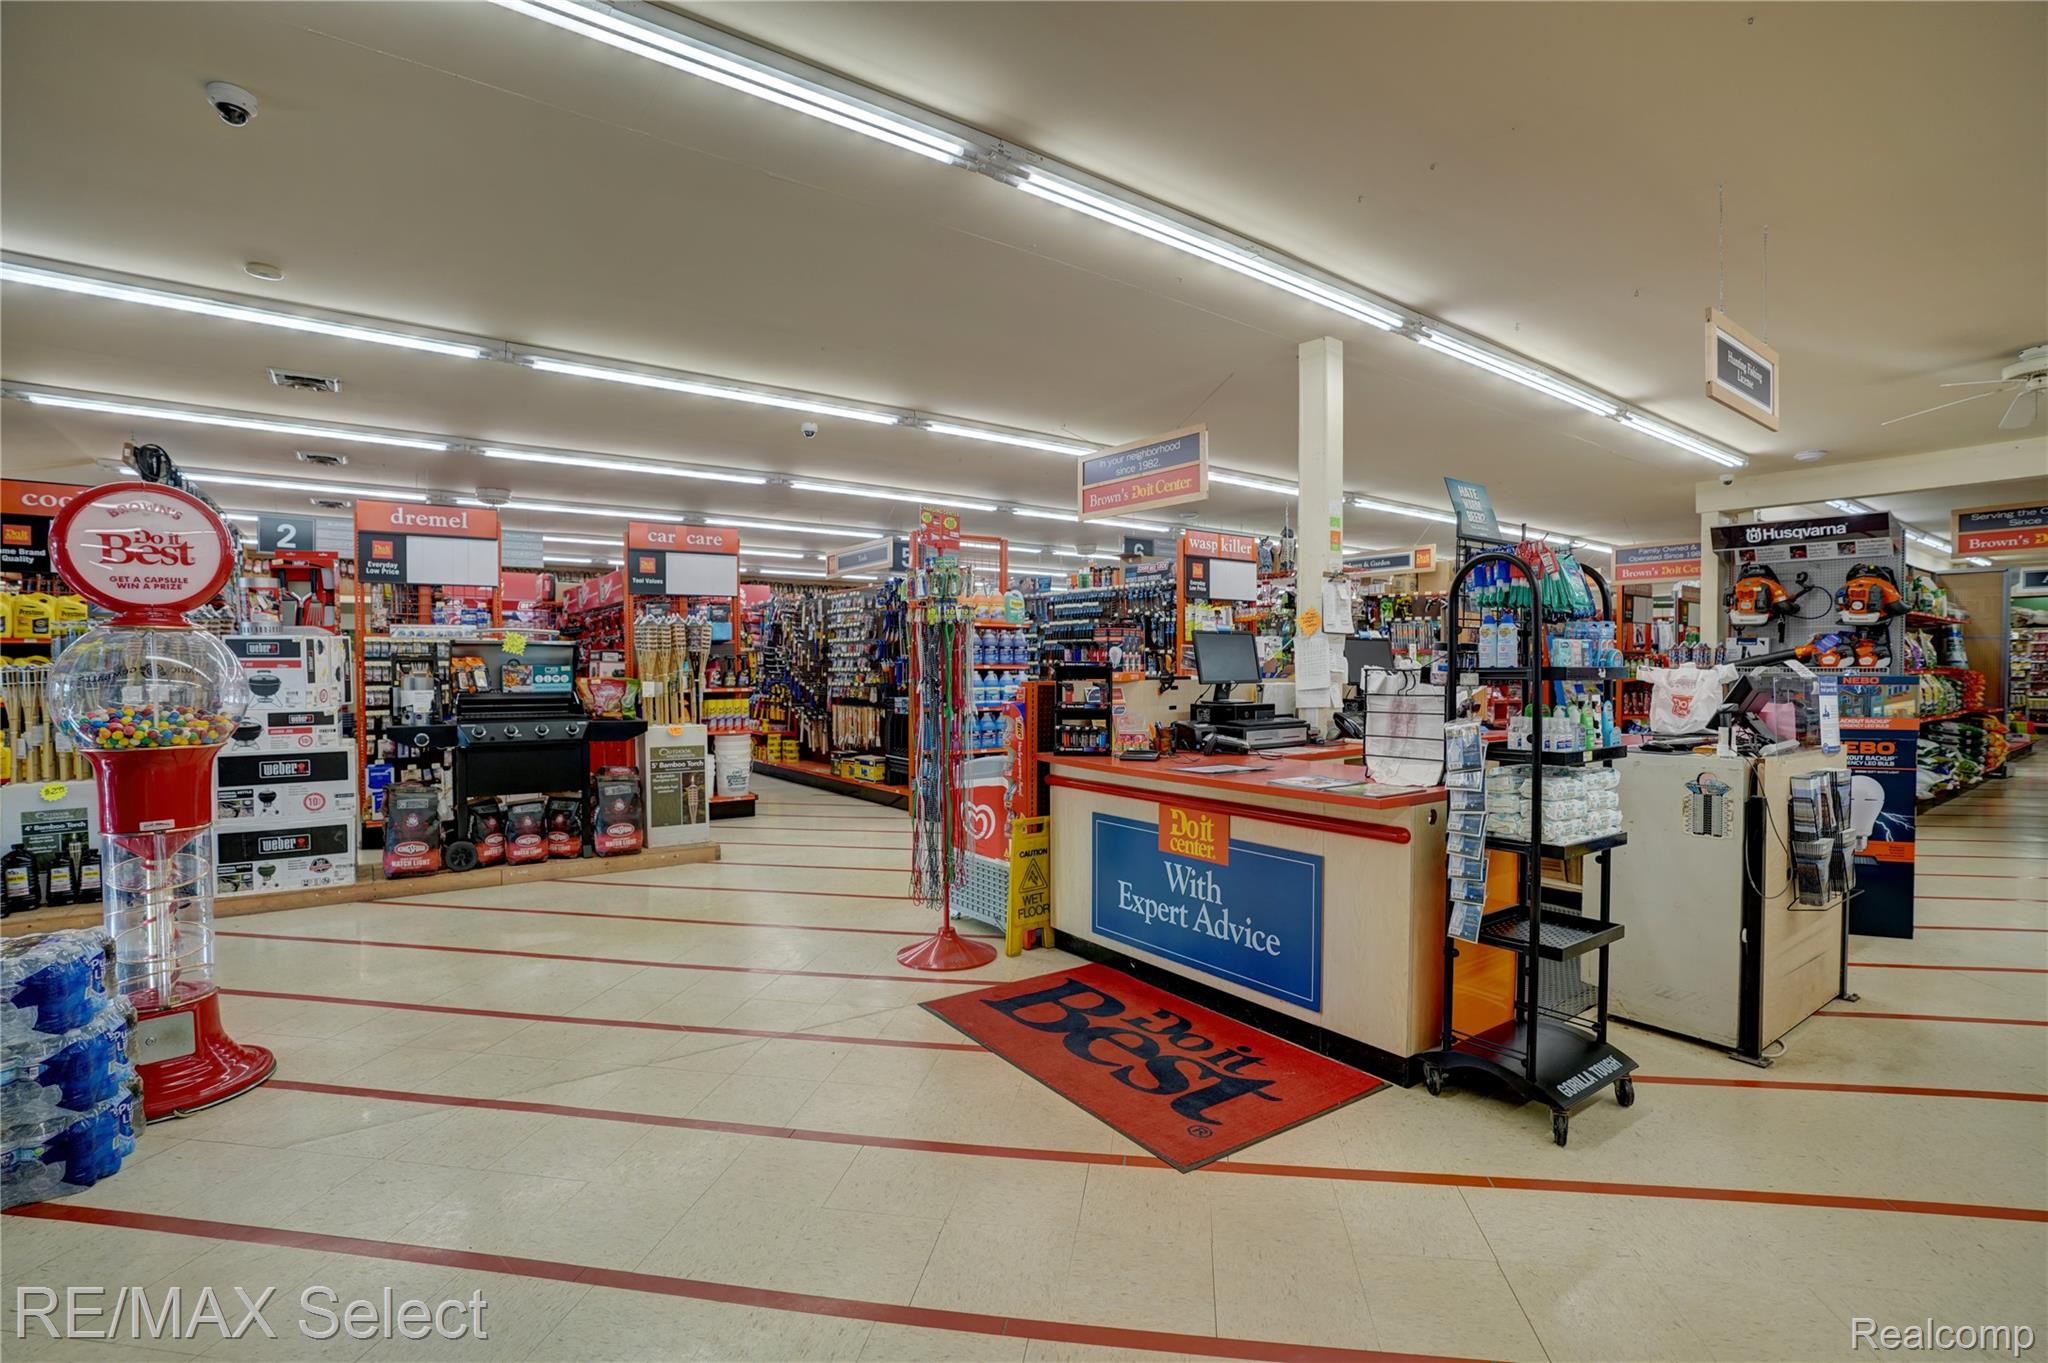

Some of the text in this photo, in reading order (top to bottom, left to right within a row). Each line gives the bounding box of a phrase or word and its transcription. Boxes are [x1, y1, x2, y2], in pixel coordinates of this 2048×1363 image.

[1107, 455, 1125, 469] your
[1126, 440, 1181, 461] neighborhood
[1116, 465, 1136, 476] since
[1090, 487, 1128, 507] Brown's
[106, 502, 183, 520] BROWN'S
[390, 507, 469, 529] dremel
[1971, 512, 2014, 522] Serving
[2017, 508, 2037, 517] the
[2008, 518, 2042, 527] Since
[276, 523, 297, 549] 2
[647, 531, 723, 546] car care
[1763, 523, 1847, 541] Husqvarna
[96, 533, 196, 566] Best
[1189, 538, 1252, 554] wasp killer
[1969, 534, 2030, 550] Brown's
[18, 548, 46, 557] Brand
[1638, 547, 1661, 555] Family
[1662, 545, 1689, 553] Owned
[1, 555, 34, 564] Quality
[367, 560, 399, 570] Everyday
[1370, 559, 1391, 568] Garden
[1628, 554, 1663, 563] Operated
[366, 567, 399, 576] Low Price
[1622, 567, 1658, 578] Brown's
[109, 575, 189, 584] GET A CAPSULE
[116, 582, 140, 590] WIN
[1843, 677, 1879, 685] NEBO
[1846, 741, 1896, 756] EBO
[263, 762, 297, 776] weber
[34, 823, 66, 832] Bamboo
[1169, 808, 1215, 842] Do it
[262, 838, 297, 851] weber
[1019, 848, 1048, 859] CAUTION
[1164, 861, 1223, 905] With
[1022, 892, 1044, 907] WET
[1018, 903, 1050, 920] FLOOR
[1117, 879, 1281, 956] Expert Advice
[1128, 1008, 1213, 1050] Do
[980, 977, 1283, 1126] Best
[1556, 1054, 1623, 1097] GORILLA TOUGH
